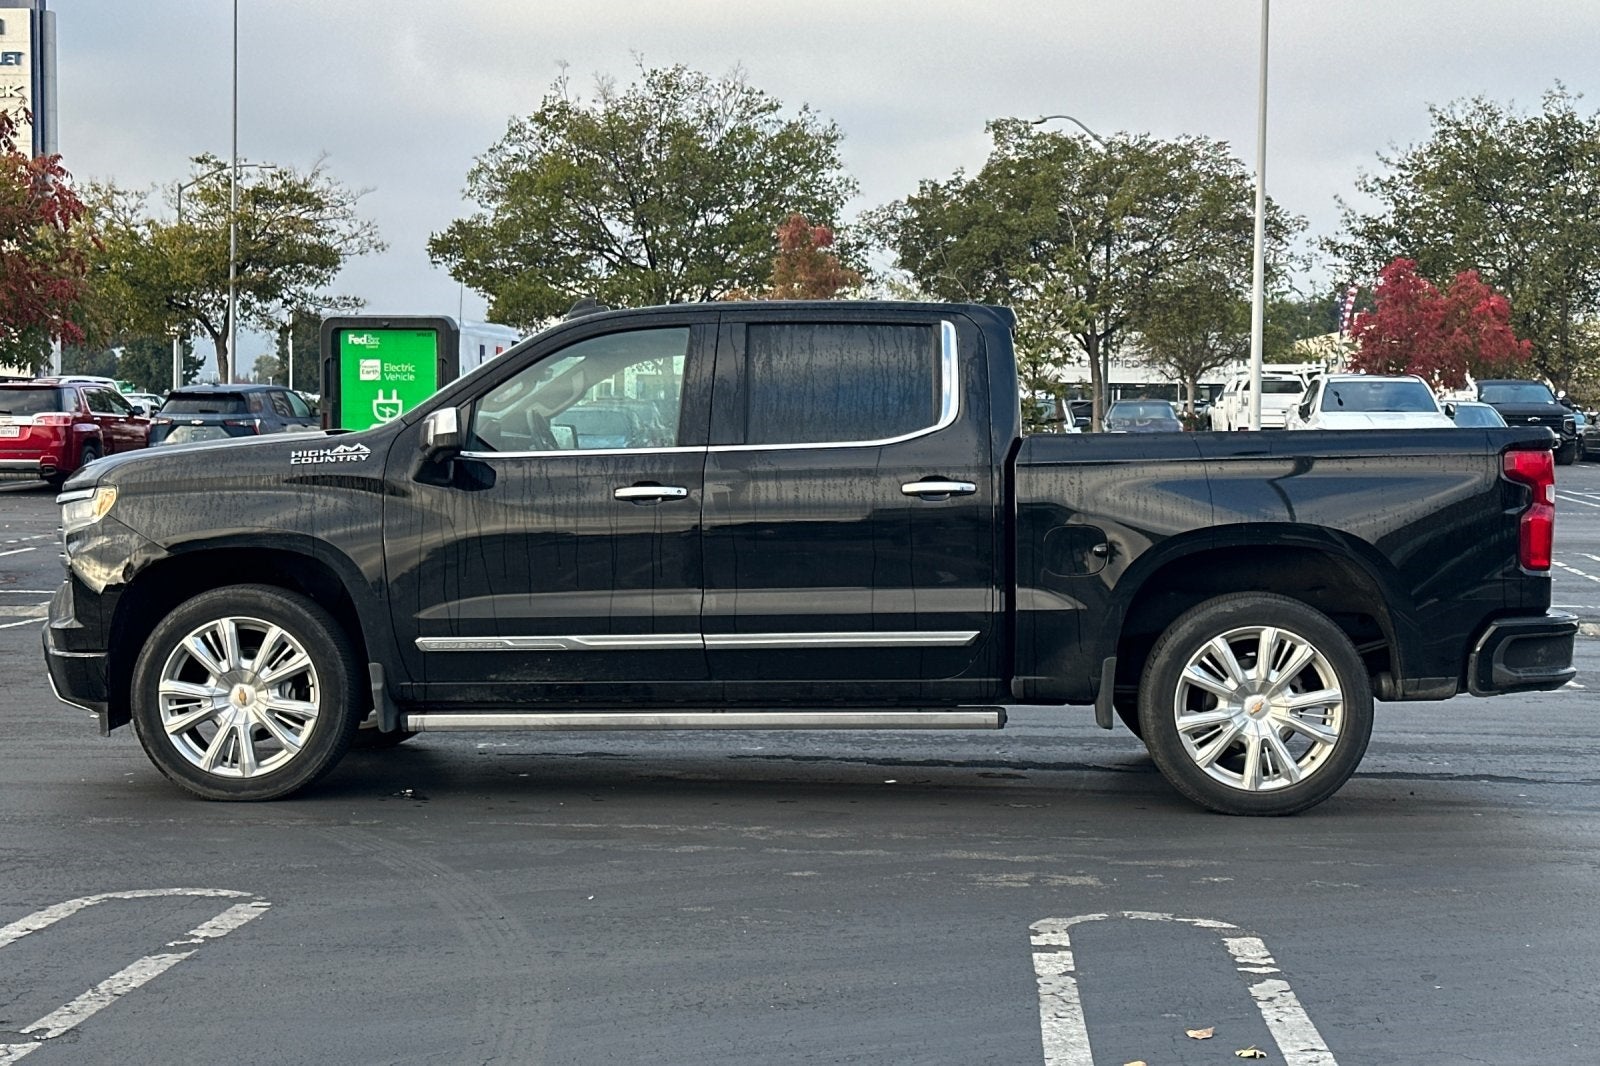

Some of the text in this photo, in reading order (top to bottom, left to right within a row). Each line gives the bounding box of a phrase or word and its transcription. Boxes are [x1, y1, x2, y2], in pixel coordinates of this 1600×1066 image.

[0, 52, 24, 65] ET
[384, 363, 416, 372] Electric
[1079, 359, 1140, 369] CEIFIED
[384, 373, 416, 381] Vehicle
[291, 449, 331, 457] HIGH
[290, 454, 369, 465] COUNTRY
